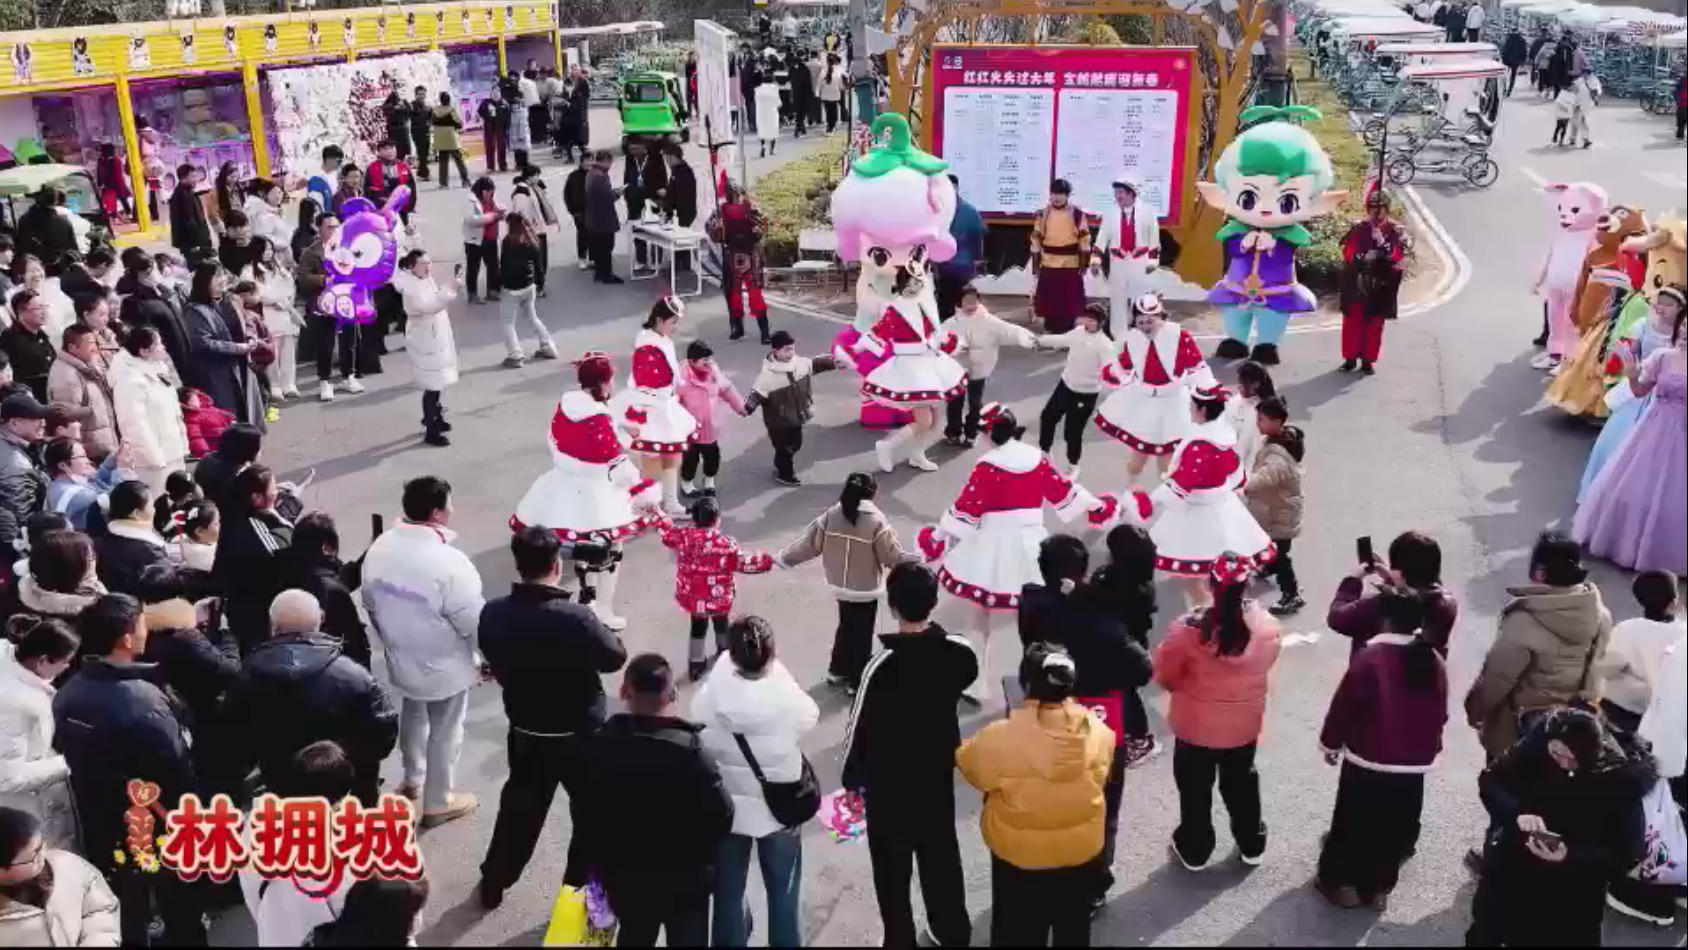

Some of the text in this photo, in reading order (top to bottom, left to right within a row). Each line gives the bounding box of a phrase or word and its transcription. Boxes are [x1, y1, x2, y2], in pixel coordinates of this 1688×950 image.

[963, 71, 1056, 85] 红红火火过大年
